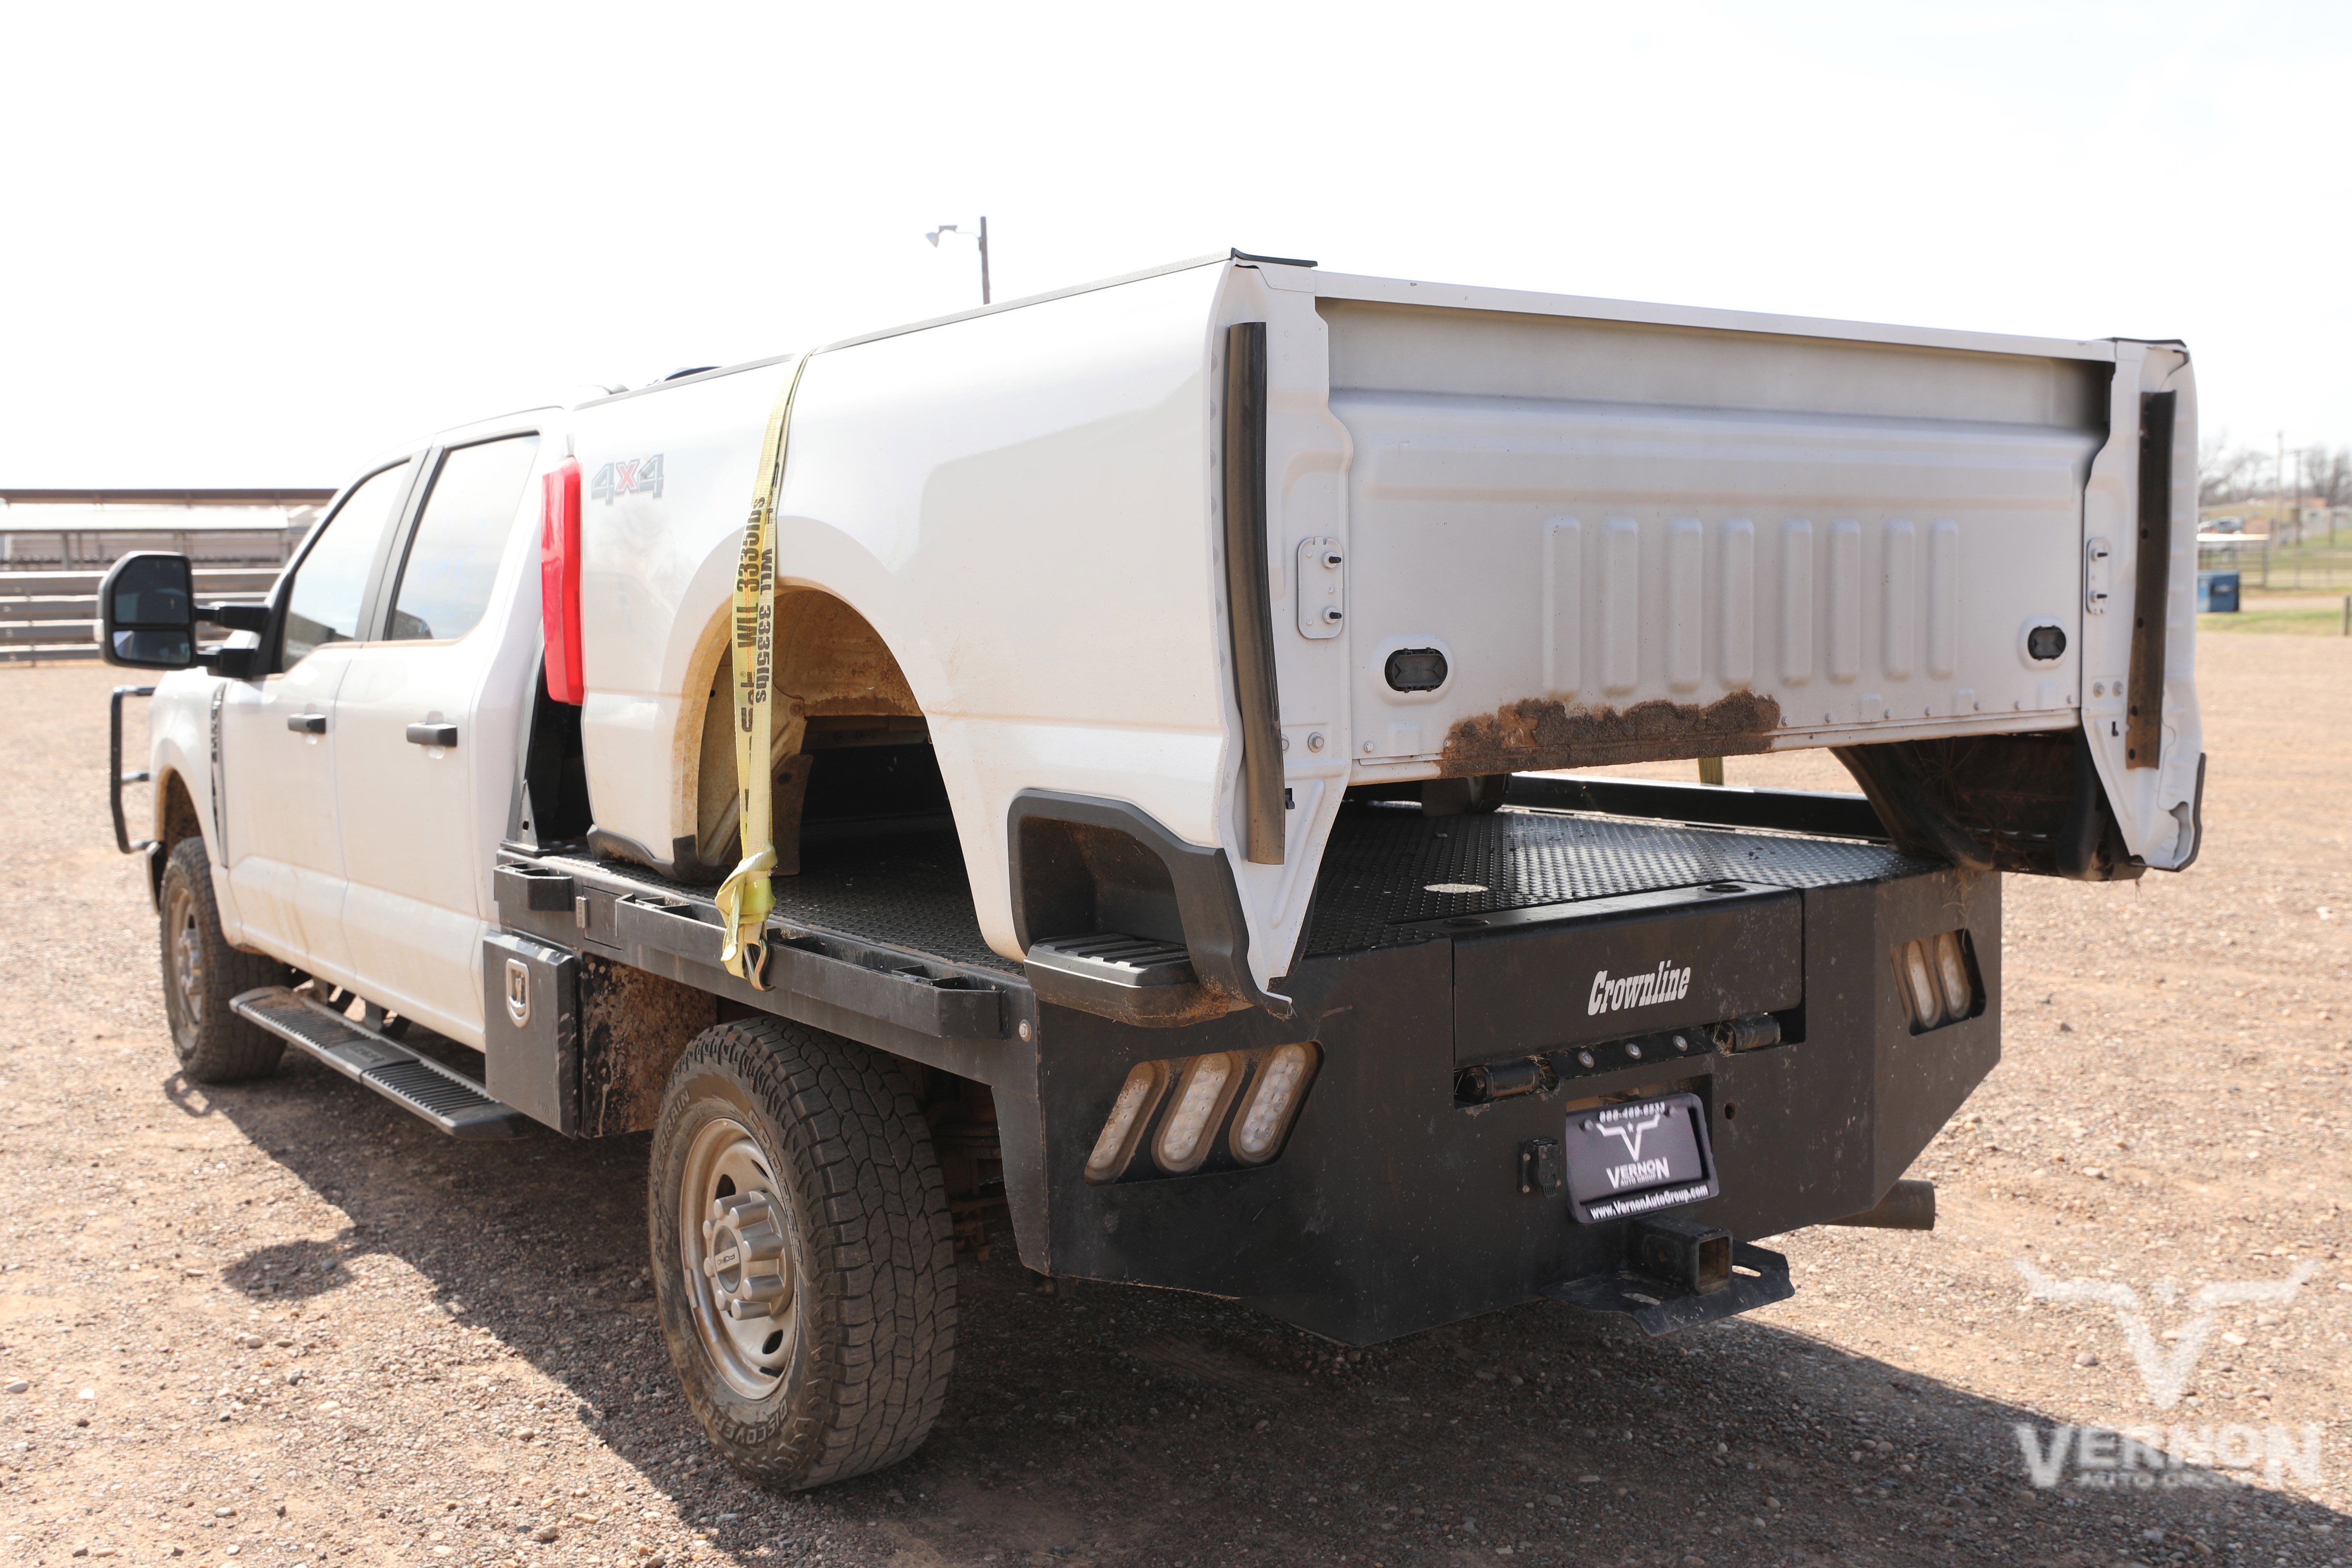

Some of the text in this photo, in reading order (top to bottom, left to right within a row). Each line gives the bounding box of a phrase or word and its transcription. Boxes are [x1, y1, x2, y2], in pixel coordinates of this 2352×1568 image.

[737, 497, 766, 593] 3335lbs
[755, 548, 773, 703] WLL 3335lbs
[1587, 960, 1690, 1016] Crownline
[1606, 1156, 1670, 1189] VERNON
[1590, 1184, 1709, 1220] www.VernonAutoGroup.com
[717, 1252, 735, 1265] FORD
